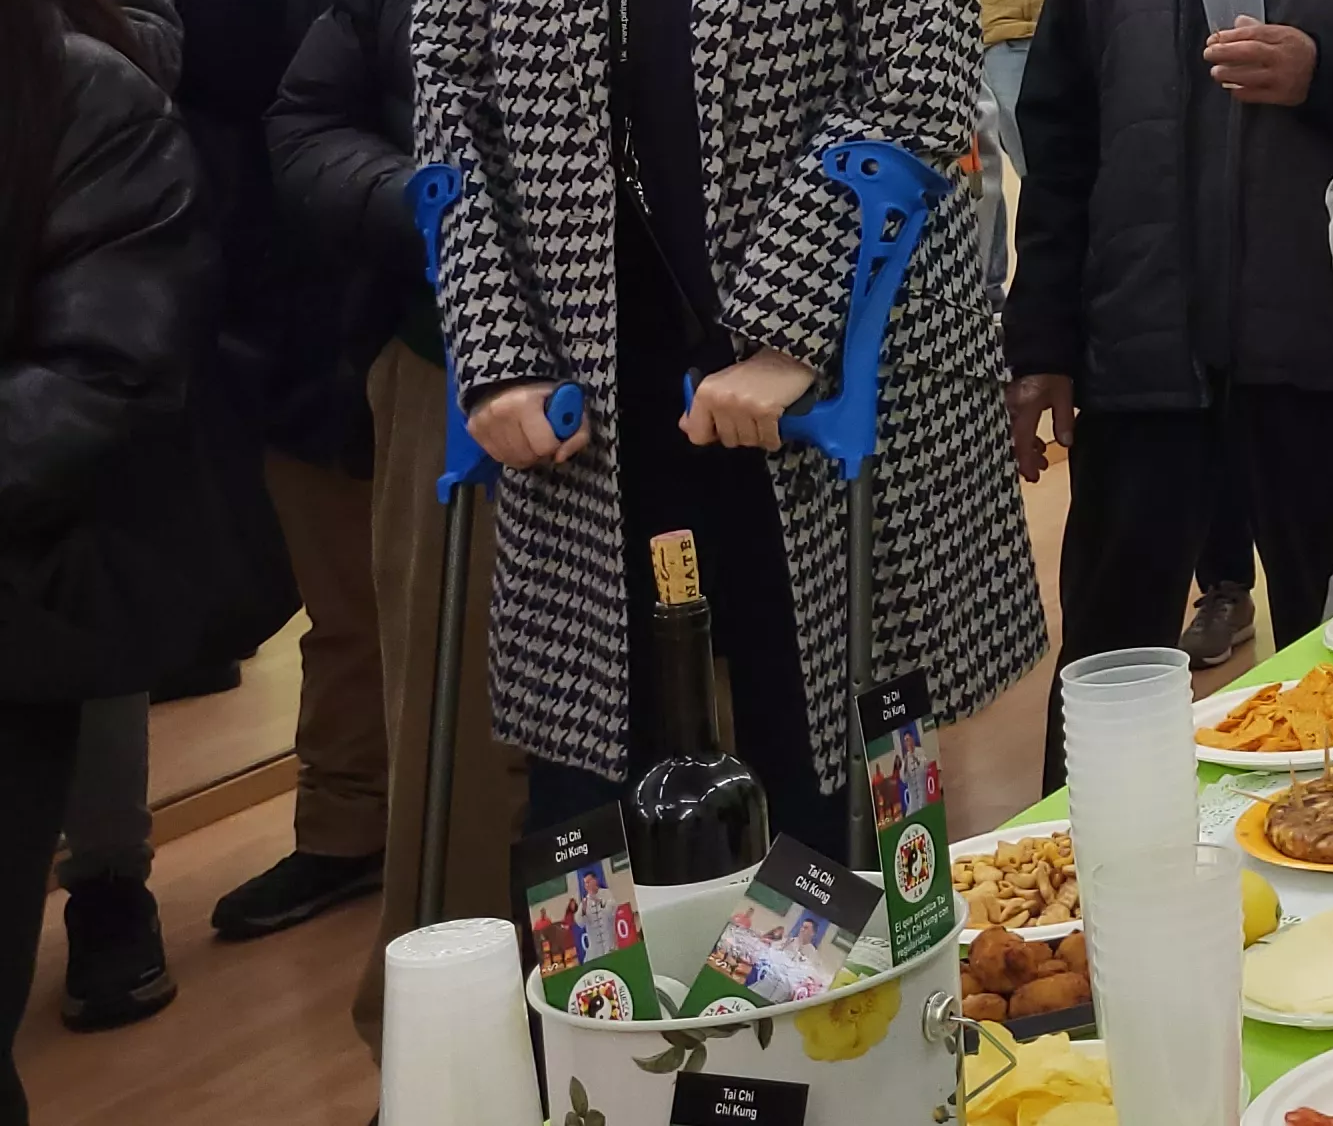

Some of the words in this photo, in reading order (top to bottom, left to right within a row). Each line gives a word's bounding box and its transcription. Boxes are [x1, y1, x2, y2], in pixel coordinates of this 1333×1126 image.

[882, 695, 892, 705] Tai
[891, 689, 901, 702] Chi
[882, 709, 892, 721] Chi
[892, 703, 906, 716] Kung
[557, 835, 568, 847] Tai
[569, 829, 582, 843] Chi
[555, 850, 568, 863] Chi
[568, 843, 589, 858] Kung
[808, 864, 820, 879] Tai
[819, 871, 836, 888] Chi
[795, 876, 810, 892] Chi
[809, 883, 831, 905] Kung
[923, 912, 939, 930] Kung
[723, 1087, 737, 1101] Tai
[738, 1089, 755, 1102] Chi
[715, 1103, 731, 1115] Chi
[733, 1104, 757, 1120] Kung
